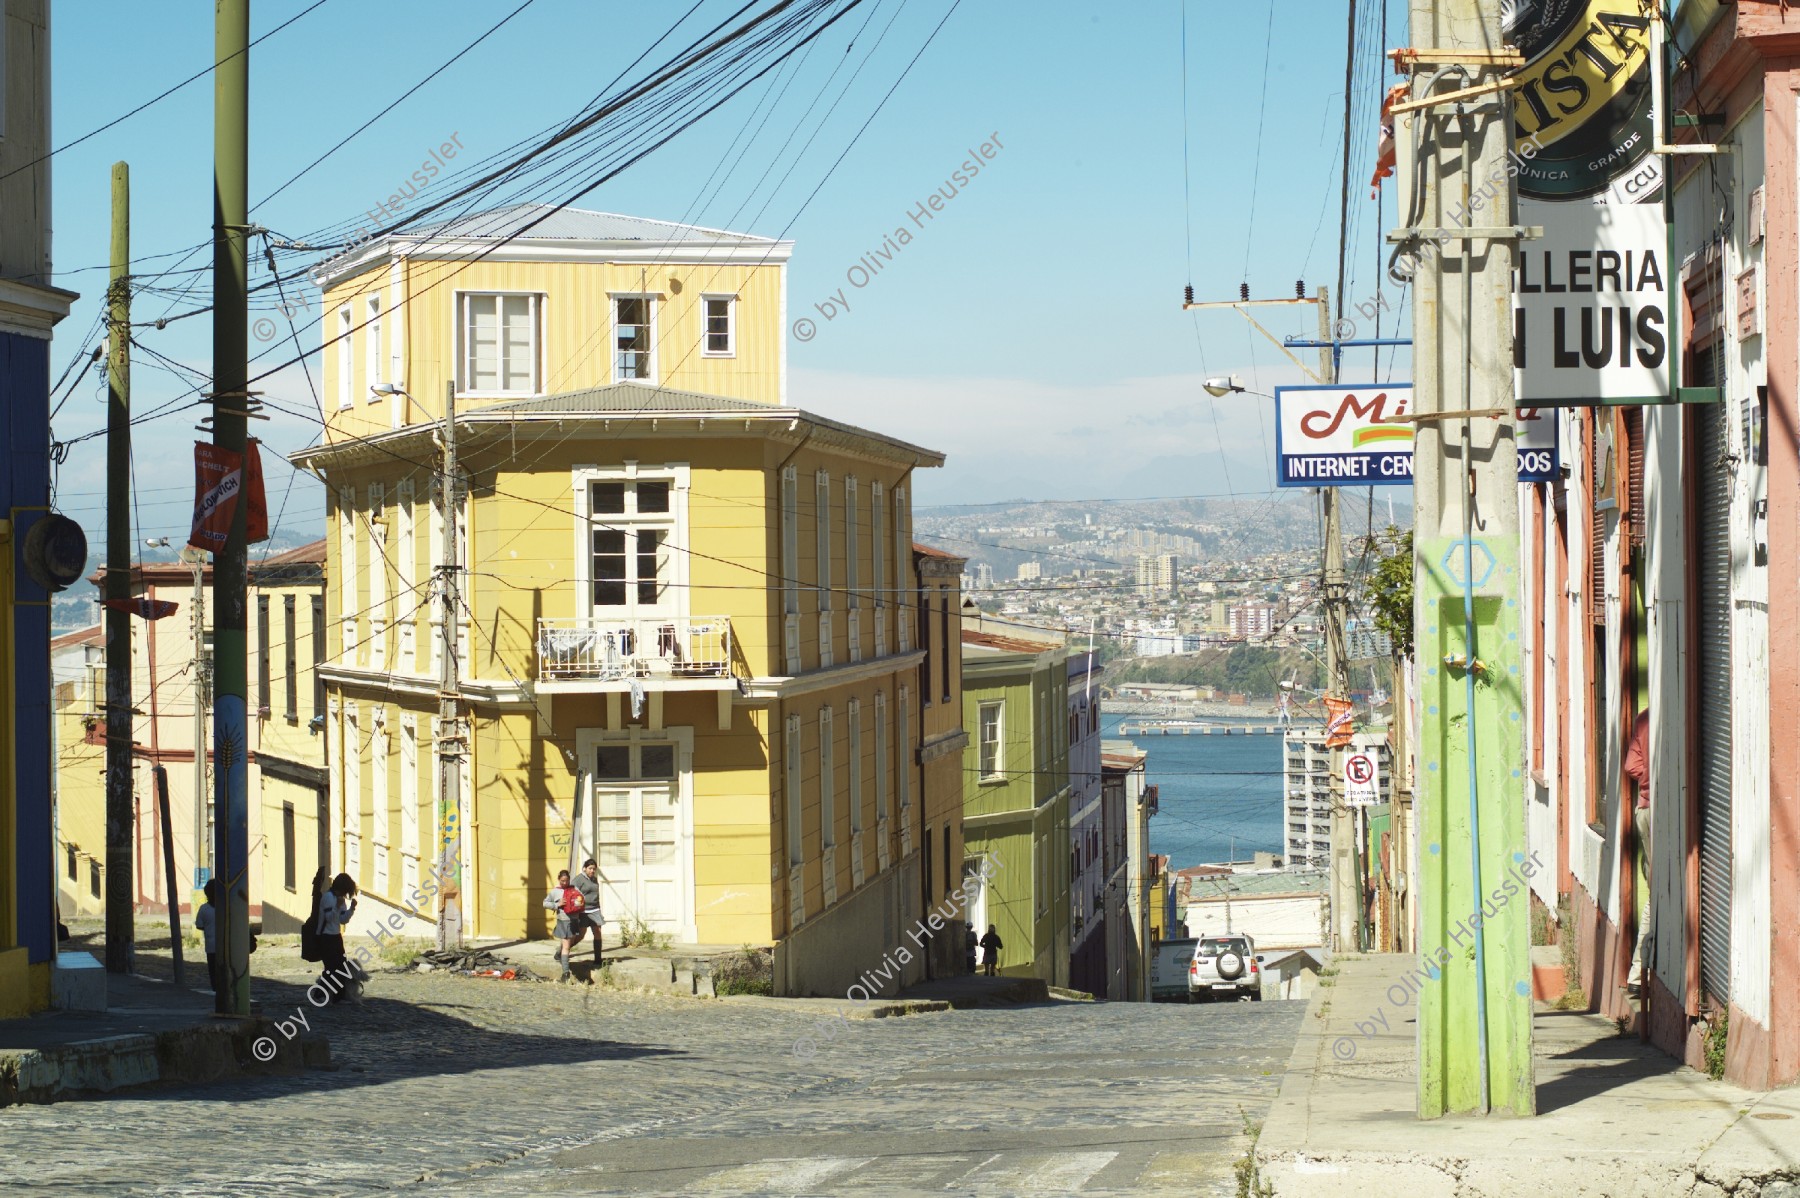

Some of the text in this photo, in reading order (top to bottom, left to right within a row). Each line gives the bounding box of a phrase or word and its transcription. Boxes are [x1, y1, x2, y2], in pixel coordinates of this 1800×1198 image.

[1588, 131, 1642, 172] GRANDE
[1624, 165, 1658, 194] CCU
[1554, 305, 1665, 369] LUIS
[1288, 455, 1369, 478] INTERNET
